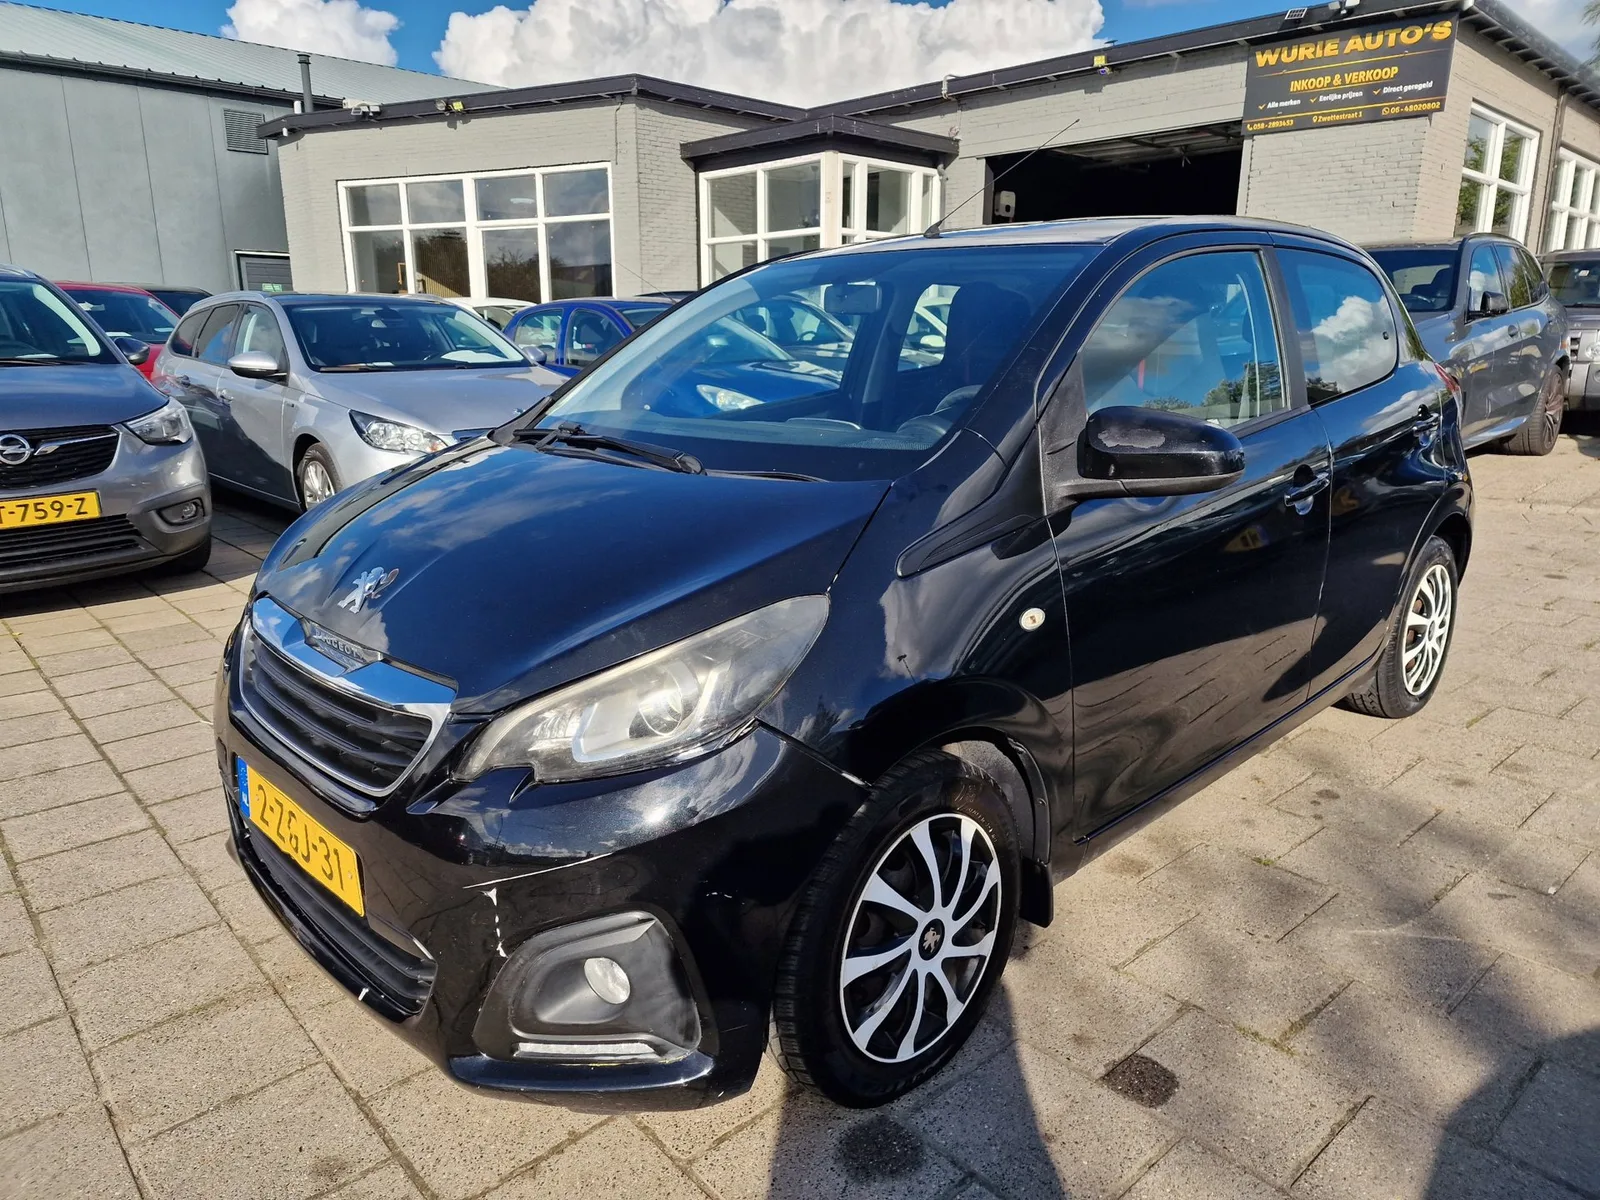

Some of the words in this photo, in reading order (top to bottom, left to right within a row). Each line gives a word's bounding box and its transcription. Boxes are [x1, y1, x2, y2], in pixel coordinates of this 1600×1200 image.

[1255, 38, 1340, 67] WURIE
[1343, 20, 1452, 54] AUTO'S
[1290, 76, 1331, 92] INKOOP
[1333, 74, 1341, 86] &
[1344, 66, 1399, 84] VERKOOP
[1383, 84, 1403, 94] Direct
[1403, 81, 1433, 92] geregeld
[1319, 92, 1341, 102] Eerlijke
[1342, 90, 1363, 100] prijzen
[1266, 101, 1279, 109] Alle
[1279, 99, 1301, 107] merken
